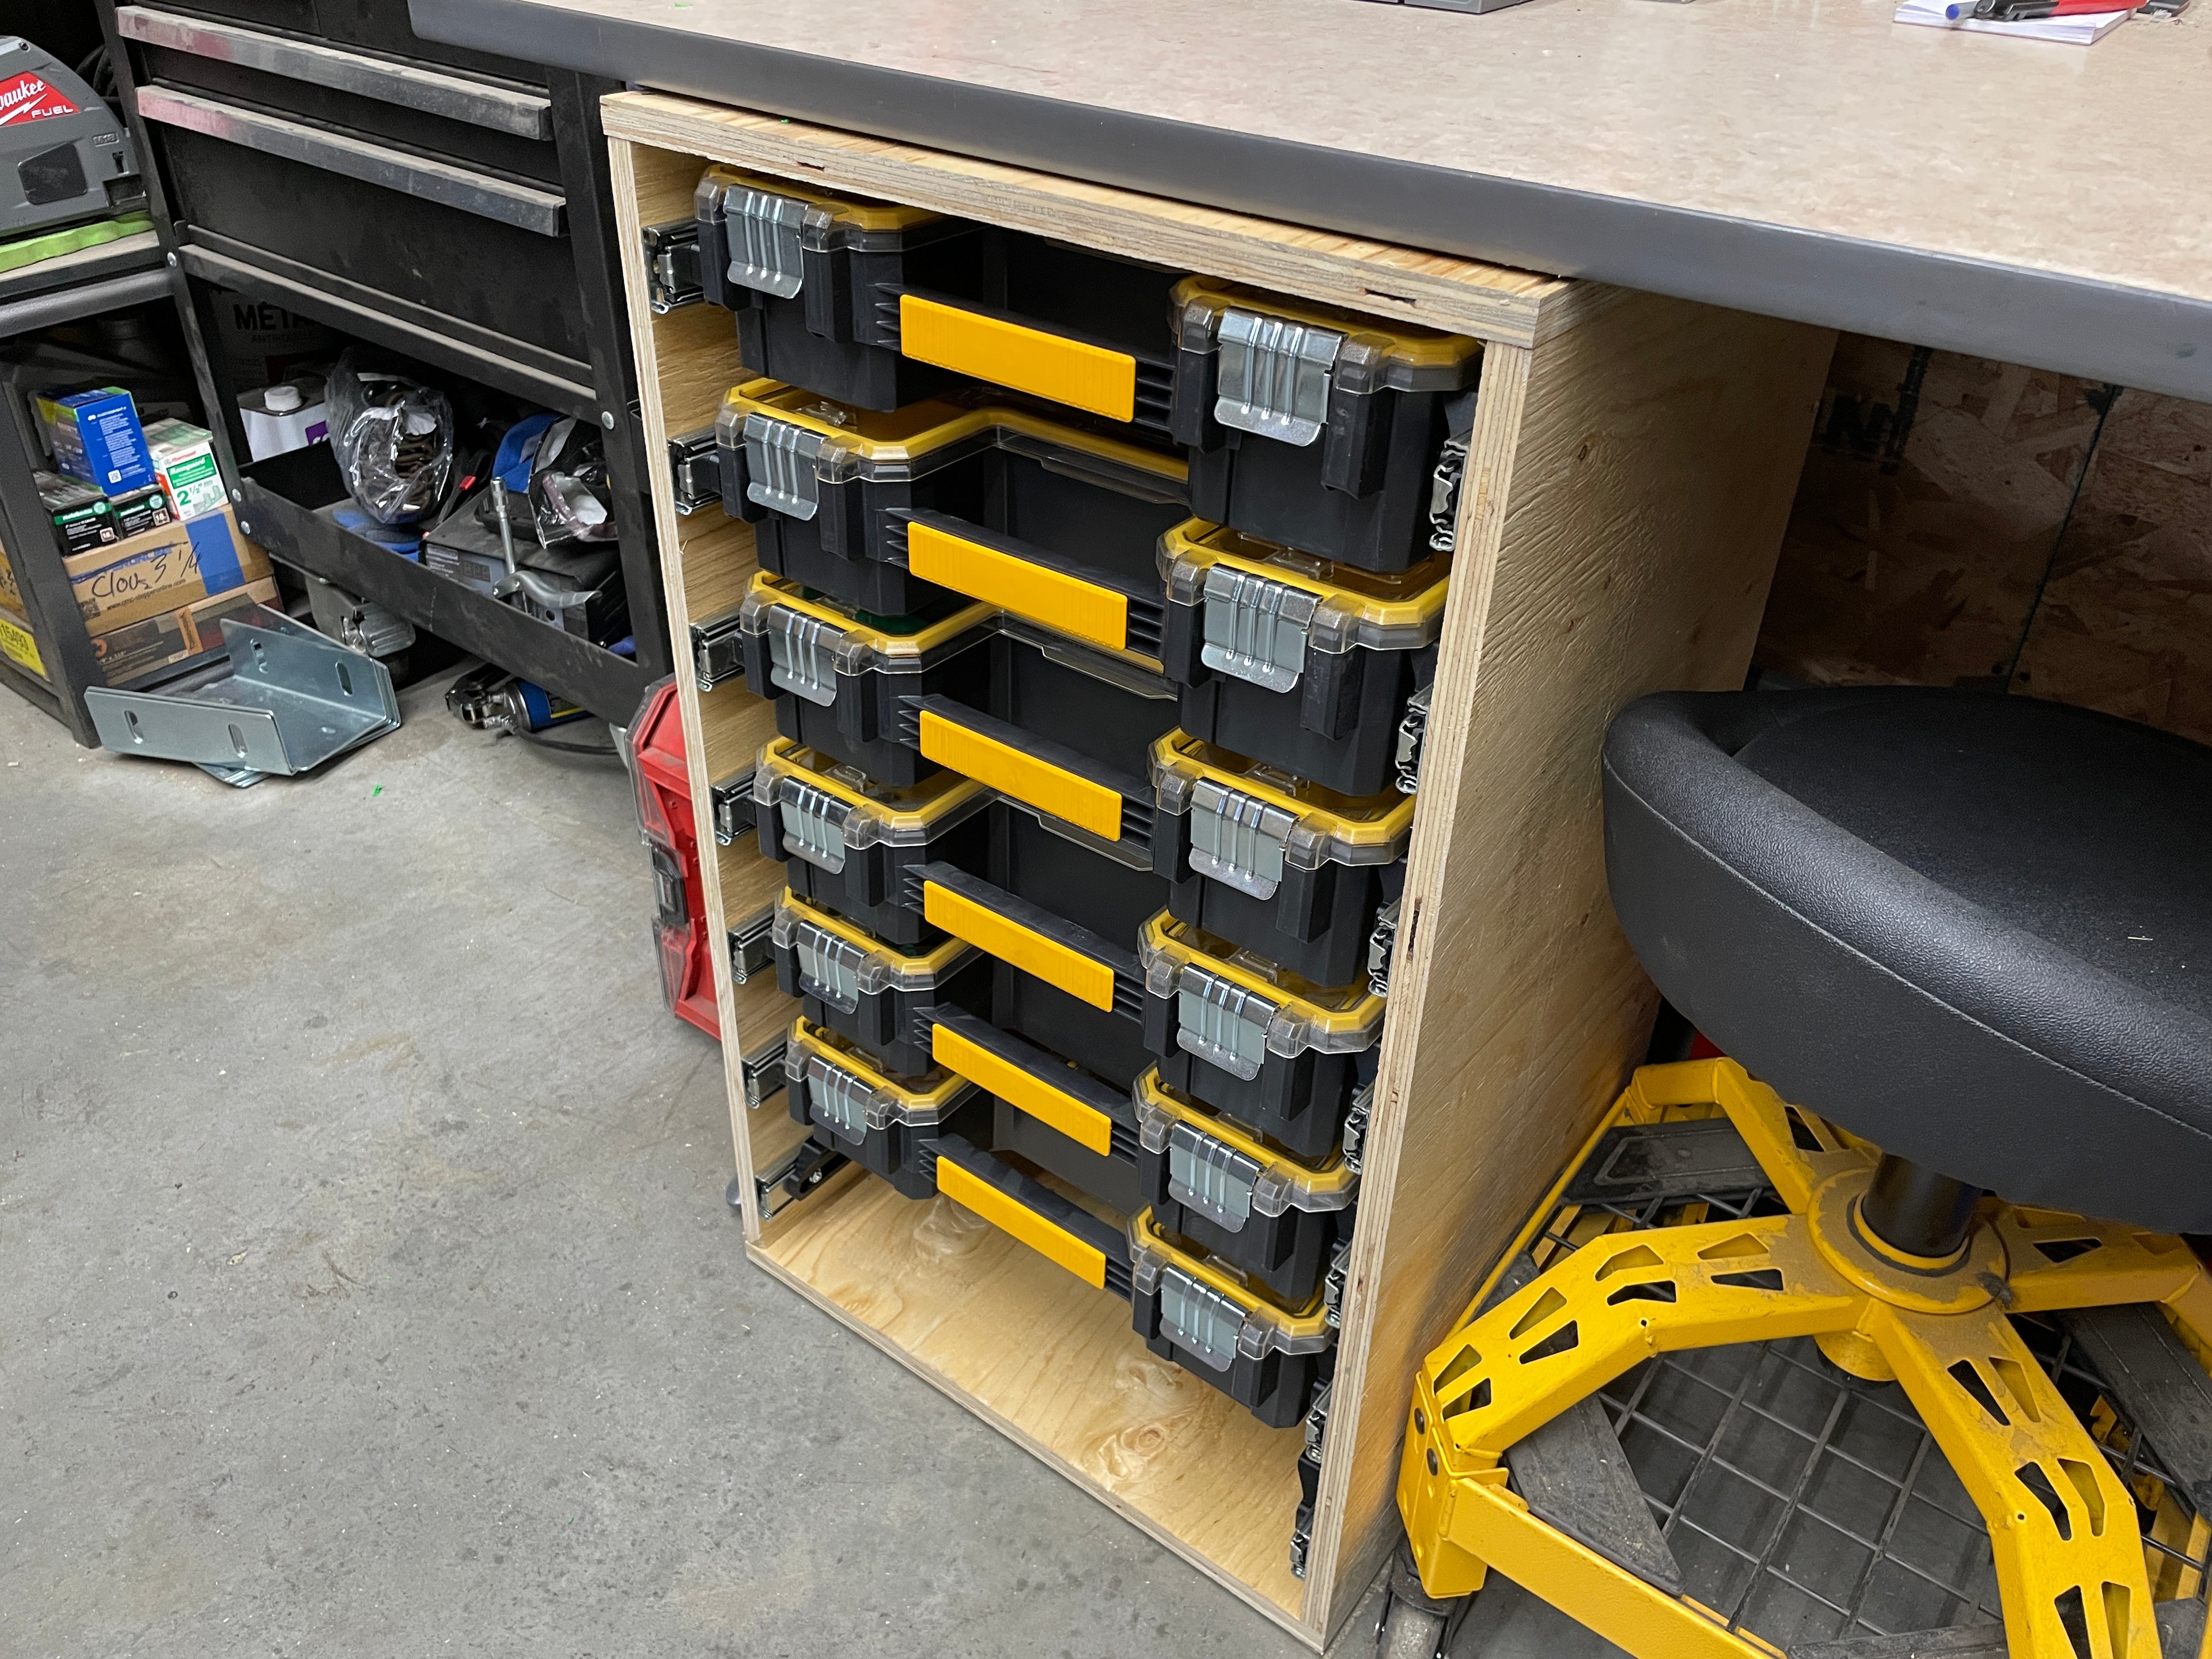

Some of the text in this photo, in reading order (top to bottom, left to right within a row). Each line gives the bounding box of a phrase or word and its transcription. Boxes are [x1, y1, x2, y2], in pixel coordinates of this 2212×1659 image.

[31, 105, 74, 119] FUEL
[177, 490, 192, 506] 2
[150, 553, 167, 583] 3
